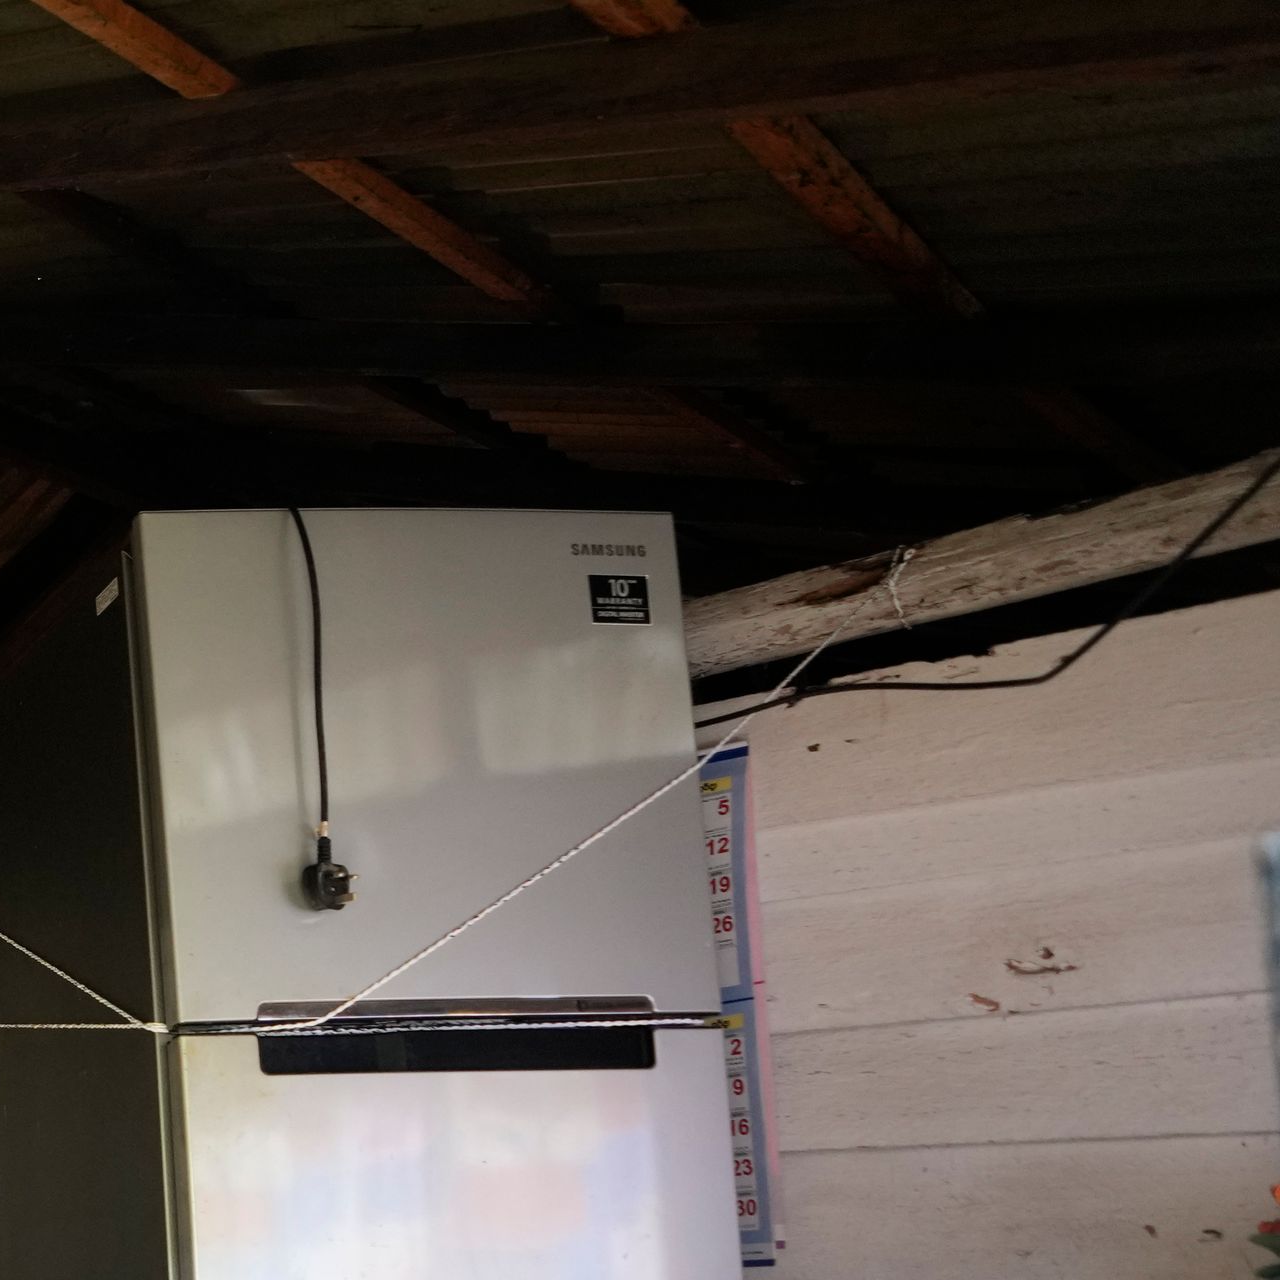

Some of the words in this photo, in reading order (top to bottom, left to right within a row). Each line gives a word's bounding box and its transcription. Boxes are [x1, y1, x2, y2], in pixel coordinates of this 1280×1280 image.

[570, 543, 648, 557] SAMSUNG
[607, 579, 629, 597] 10
[717, 799, 730, 816] 5
[705, 837, 730, 856] 12
[709, 876, 731, 895] 19
[713, 915, 734, 934] 26
[730, 1038, 742, 1056] 2
[732, 1079, 745, 1096] 9
